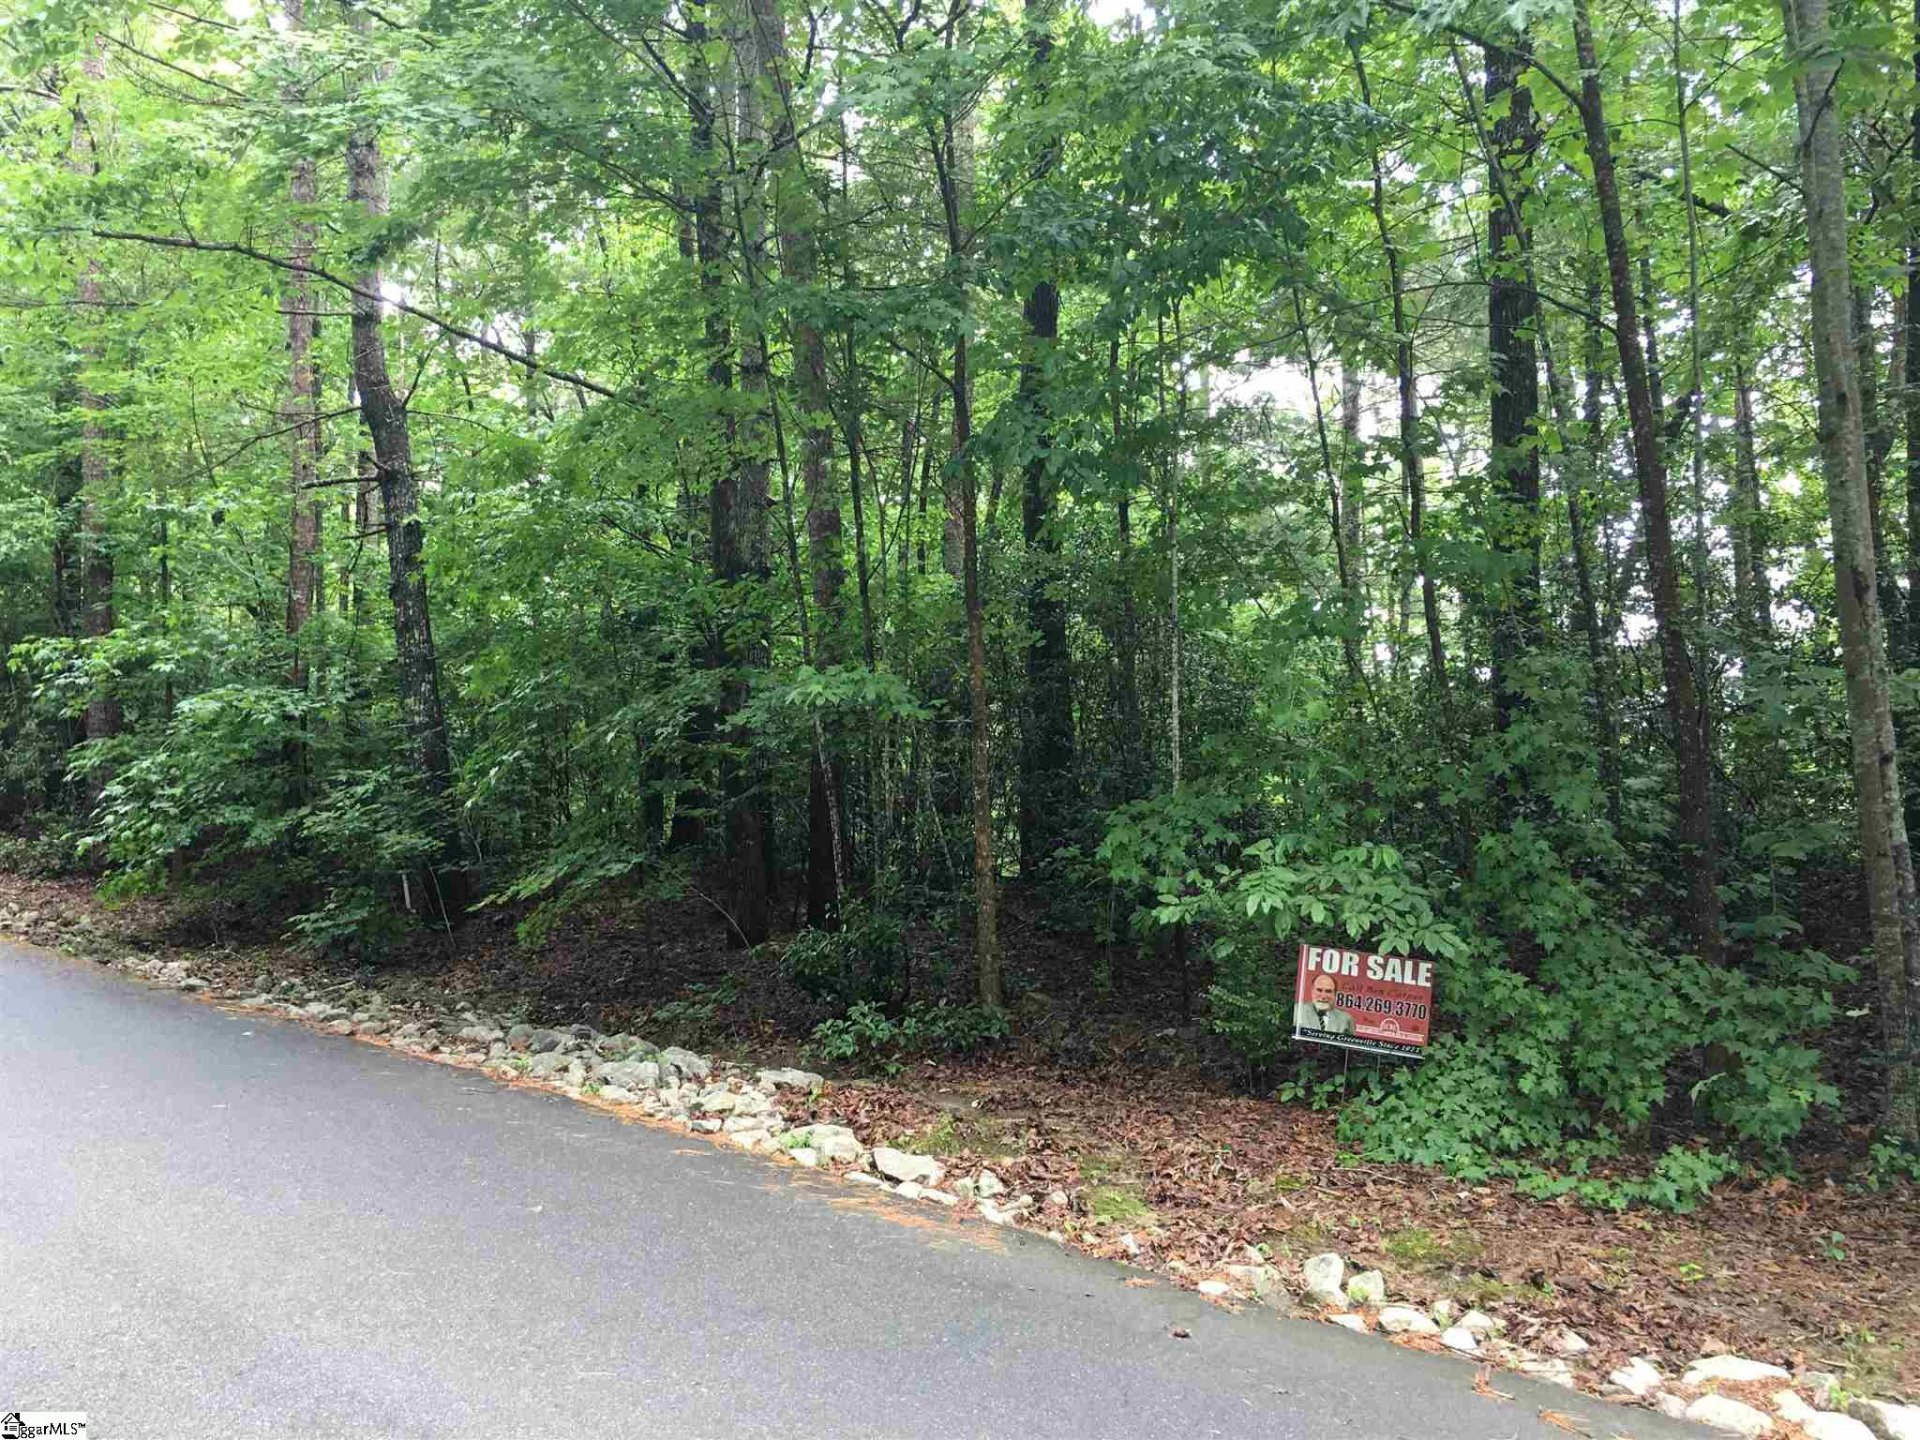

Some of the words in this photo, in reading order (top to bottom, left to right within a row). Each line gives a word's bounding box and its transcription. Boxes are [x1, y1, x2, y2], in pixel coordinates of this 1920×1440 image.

[1308, 947, 1359, 976] FOR
[1366, 954, 1432, 987] SALE
[1336, 992, 1428, 1020] 864.269.3770
